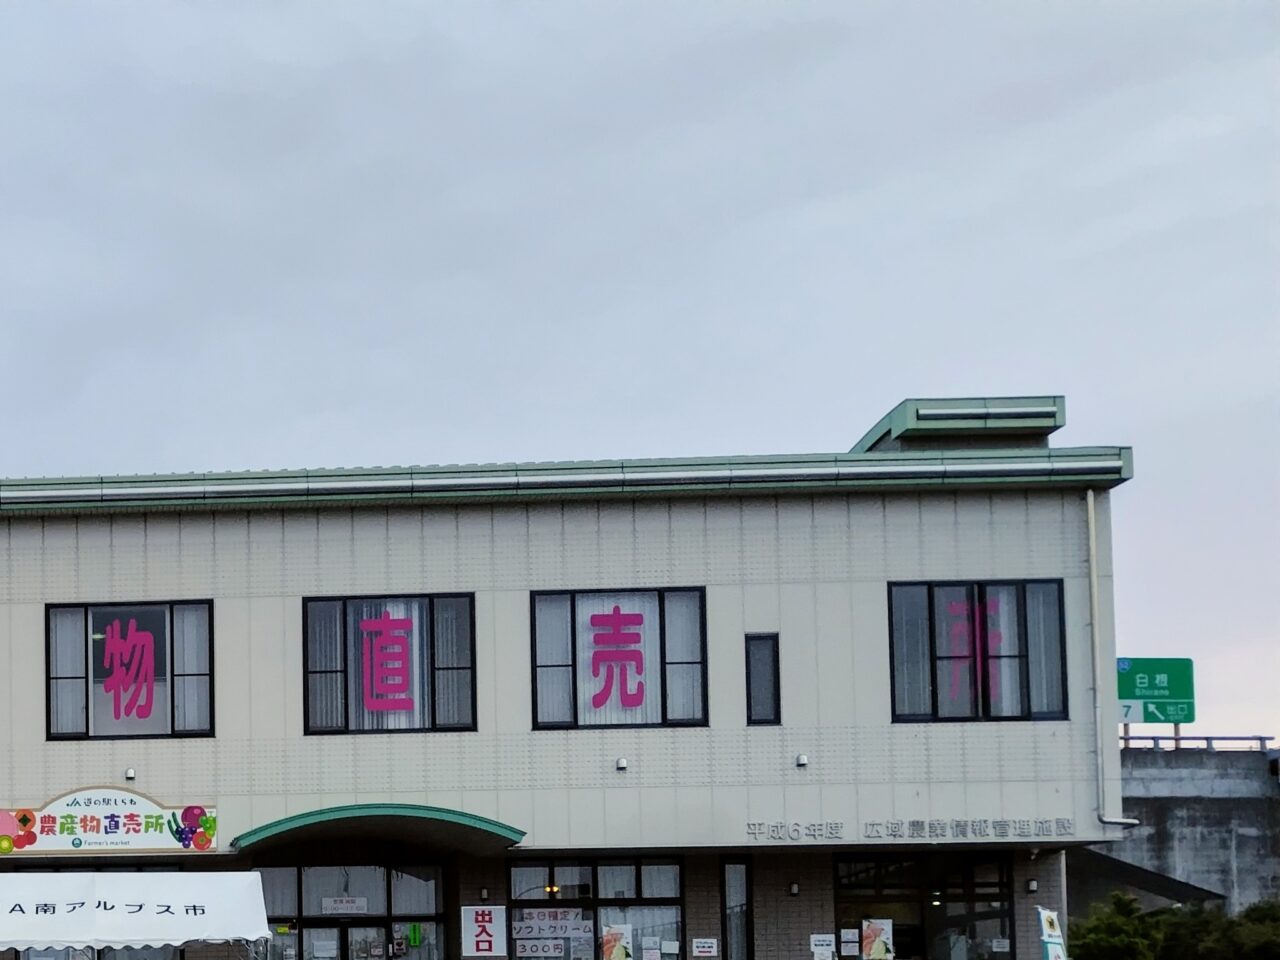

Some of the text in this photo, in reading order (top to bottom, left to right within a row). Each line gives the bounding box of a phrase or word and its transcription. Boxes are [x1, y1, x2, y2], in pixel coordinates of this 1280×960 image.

[102, 618, 156, 721] 物
[359, 609, 415, 713] 直
[589, 605, 645, 710] 売
[1122, 705, 1132, 718] 7
[39, 813, 166, 836] 農産物直売所
[474, 909, 493, 953] 出入口
[513, 925, 593, 935] ソフトクリーム
[518, 943, 563, 954] 300円
